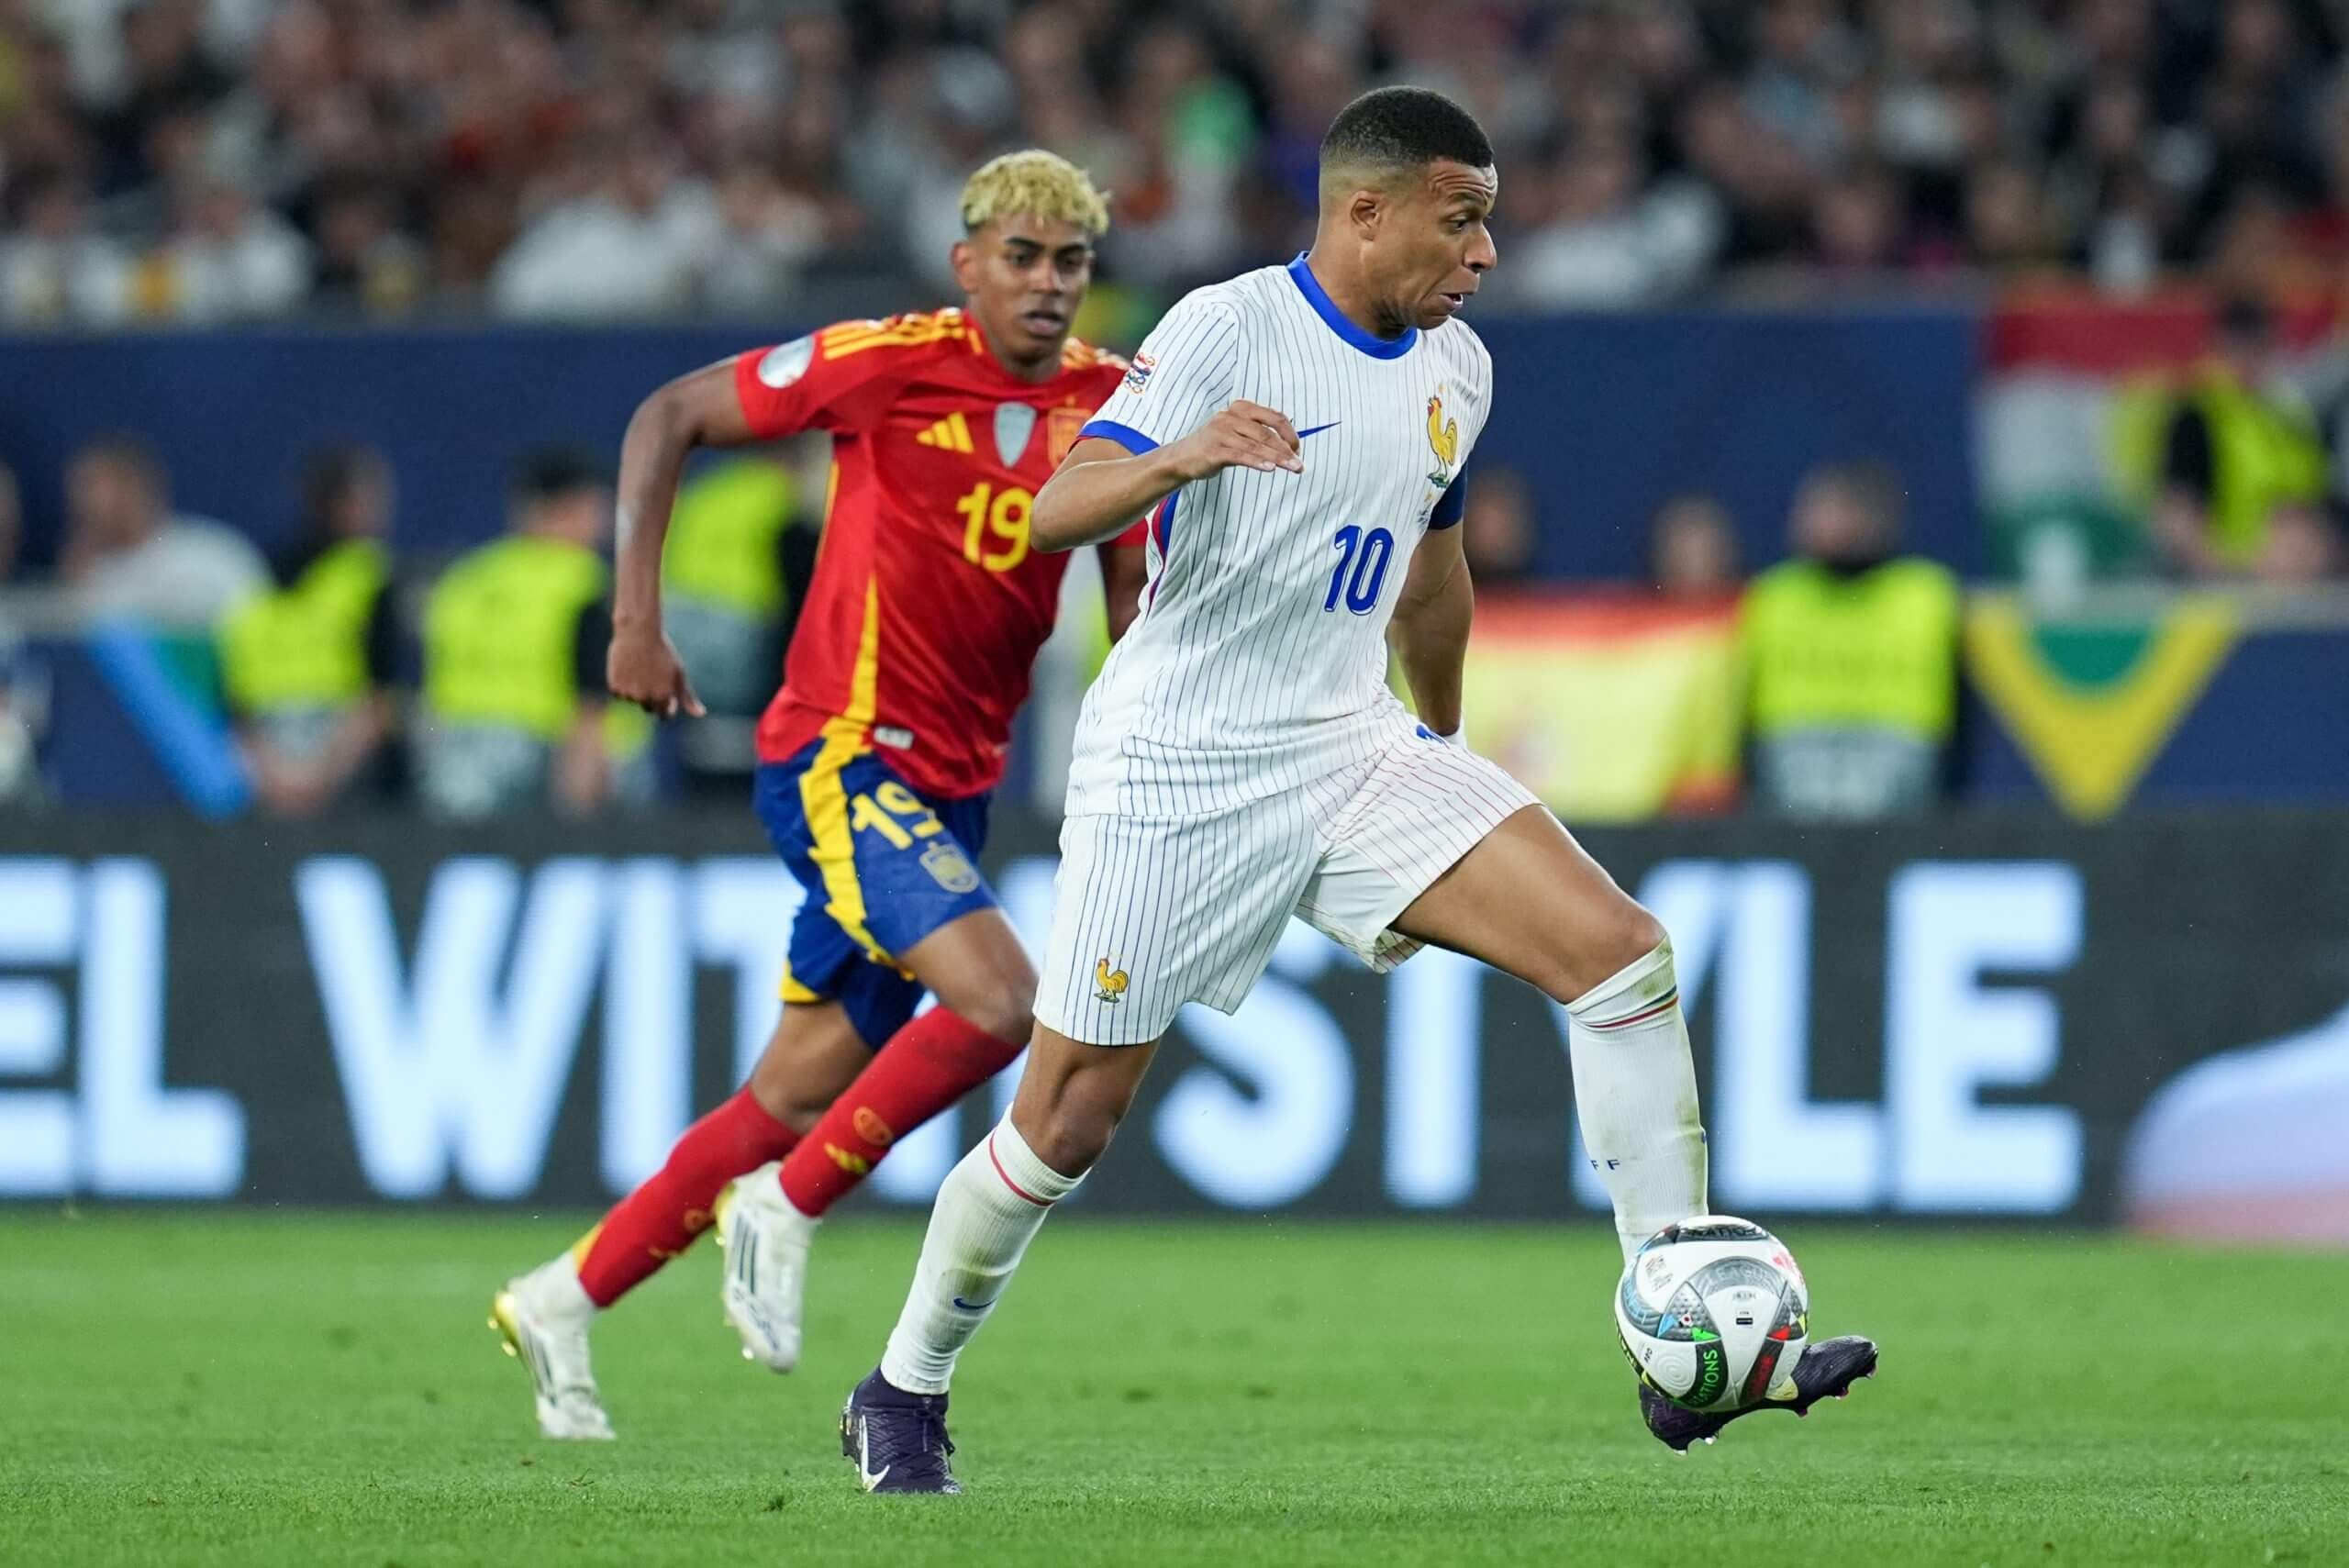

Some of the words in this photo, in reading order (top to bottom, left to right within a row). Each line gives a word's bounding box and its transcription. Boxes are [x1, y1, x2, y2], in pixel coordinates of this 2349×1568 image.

[956, 482, 1035, 573] 19
[1324, 525, 1394, 616] 10
[851, 781, 944, 850] 19
[292, 855, 1064, 1199] WI
